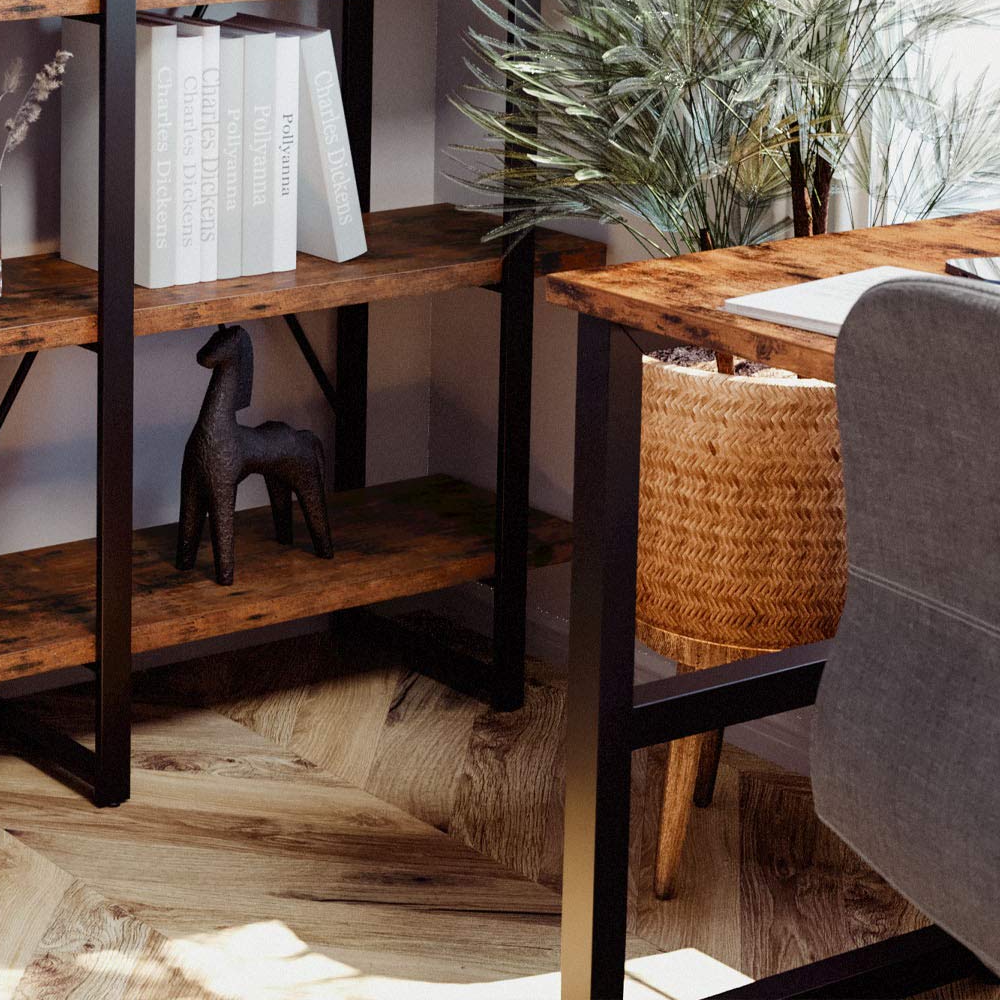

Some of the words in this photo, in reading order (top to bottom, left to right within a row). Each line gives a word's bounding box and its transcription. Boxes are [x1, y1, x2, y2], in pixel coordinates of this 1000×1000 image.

[157, 66, 173, 153] Charles
[183, 76, 198, 156] Charles
[201, 67, 219, 150] Charles
[313, 69, 340, 146] Charles
[223, 107, 241, 212] Pollyanna
[249, 104, 272, 207] Pollyanna
[278, 113, 295, 198] Pollyanna
[326, 144, 354, 226] Dickens
[156, 160, 172, 250] Dickens
[182, 163, 197, 248] Dickens
[200, 158, 219, 243] Dickens
